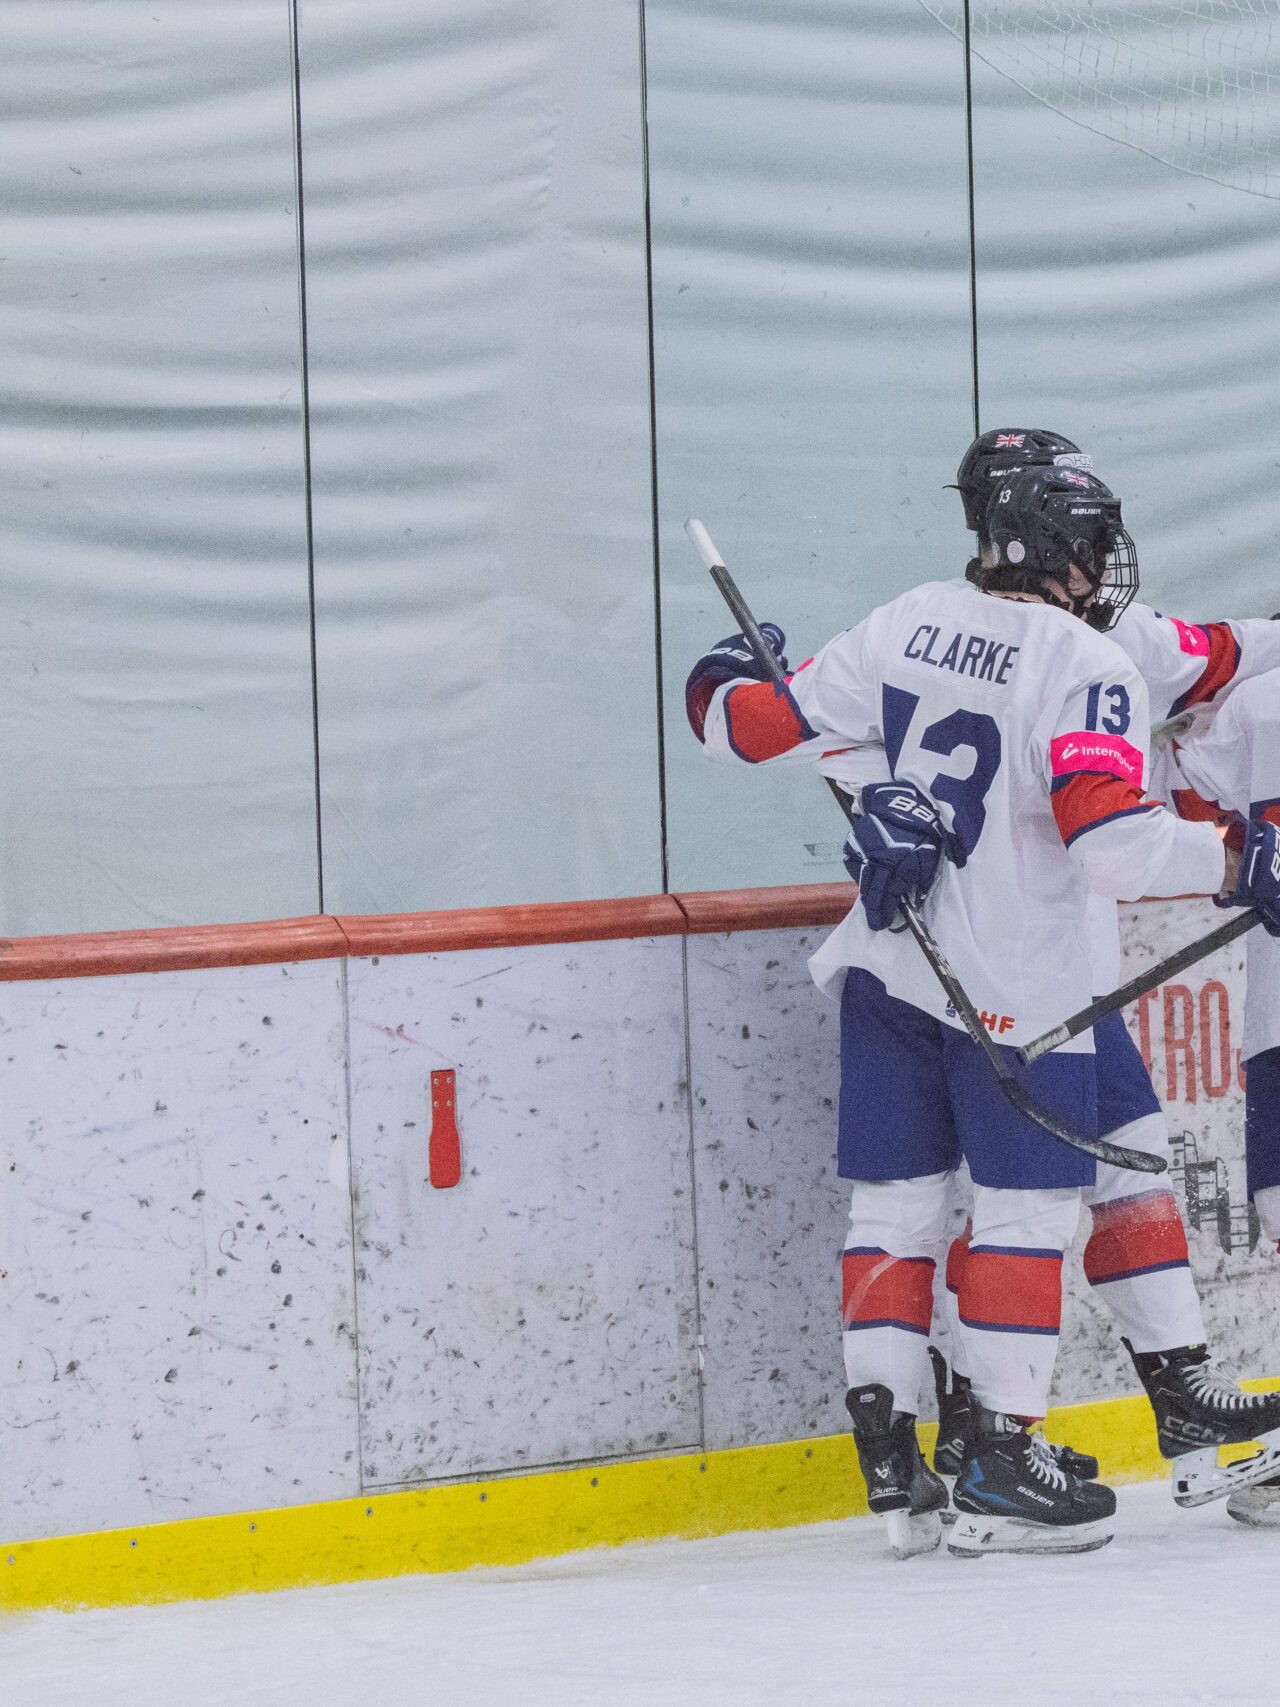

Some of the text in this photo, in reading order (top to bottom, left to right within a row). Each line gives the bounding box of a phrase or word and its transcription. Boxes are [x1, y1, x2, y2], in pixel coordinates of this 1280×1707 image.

[999, 489, 1012, 503] 13
[904, 625, 1020, 685] CLARKE
[1085, 681, 1131, 736] 13
[882, 682, 1001, 868] 13
[1016, 1485, 1055, 1507] BAUER
